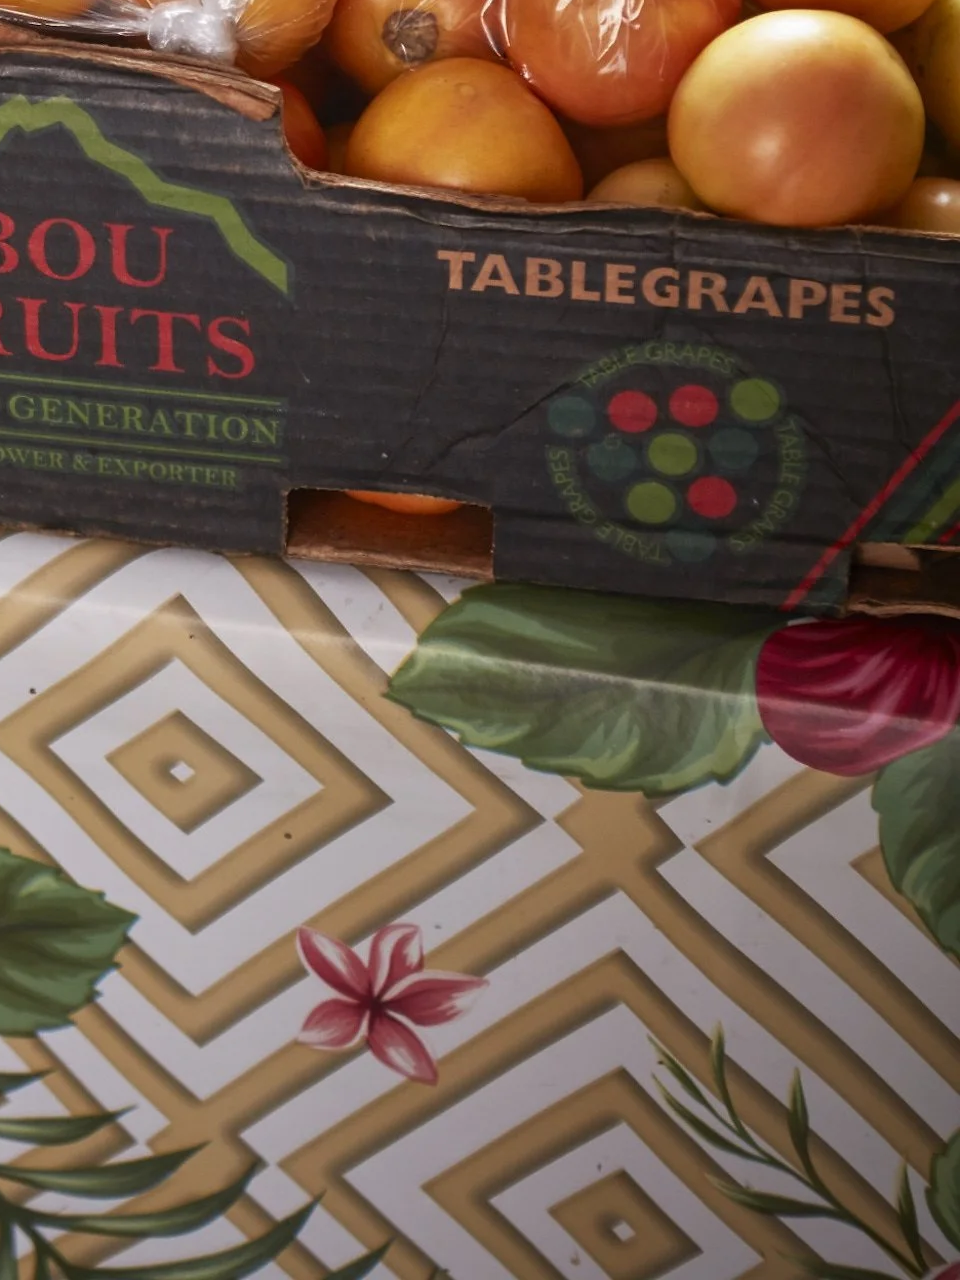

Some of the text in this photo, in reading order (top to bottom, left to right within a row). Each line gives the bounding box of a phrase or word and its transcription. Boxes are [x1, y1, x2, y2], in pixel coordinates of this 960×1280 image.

[437, 250, 896, 327] TABLEGRAPES
[577, 341, 737, 388] TABLE GRAPES
[8, 393, 282, 445] GENERATION
[72, 454, 93, 472] &
[98, 457, 239, 488] EXPORTER
[777, 420, 804, 486] TABLE
[549, 448, 663, 562] TABLE GRAPES
